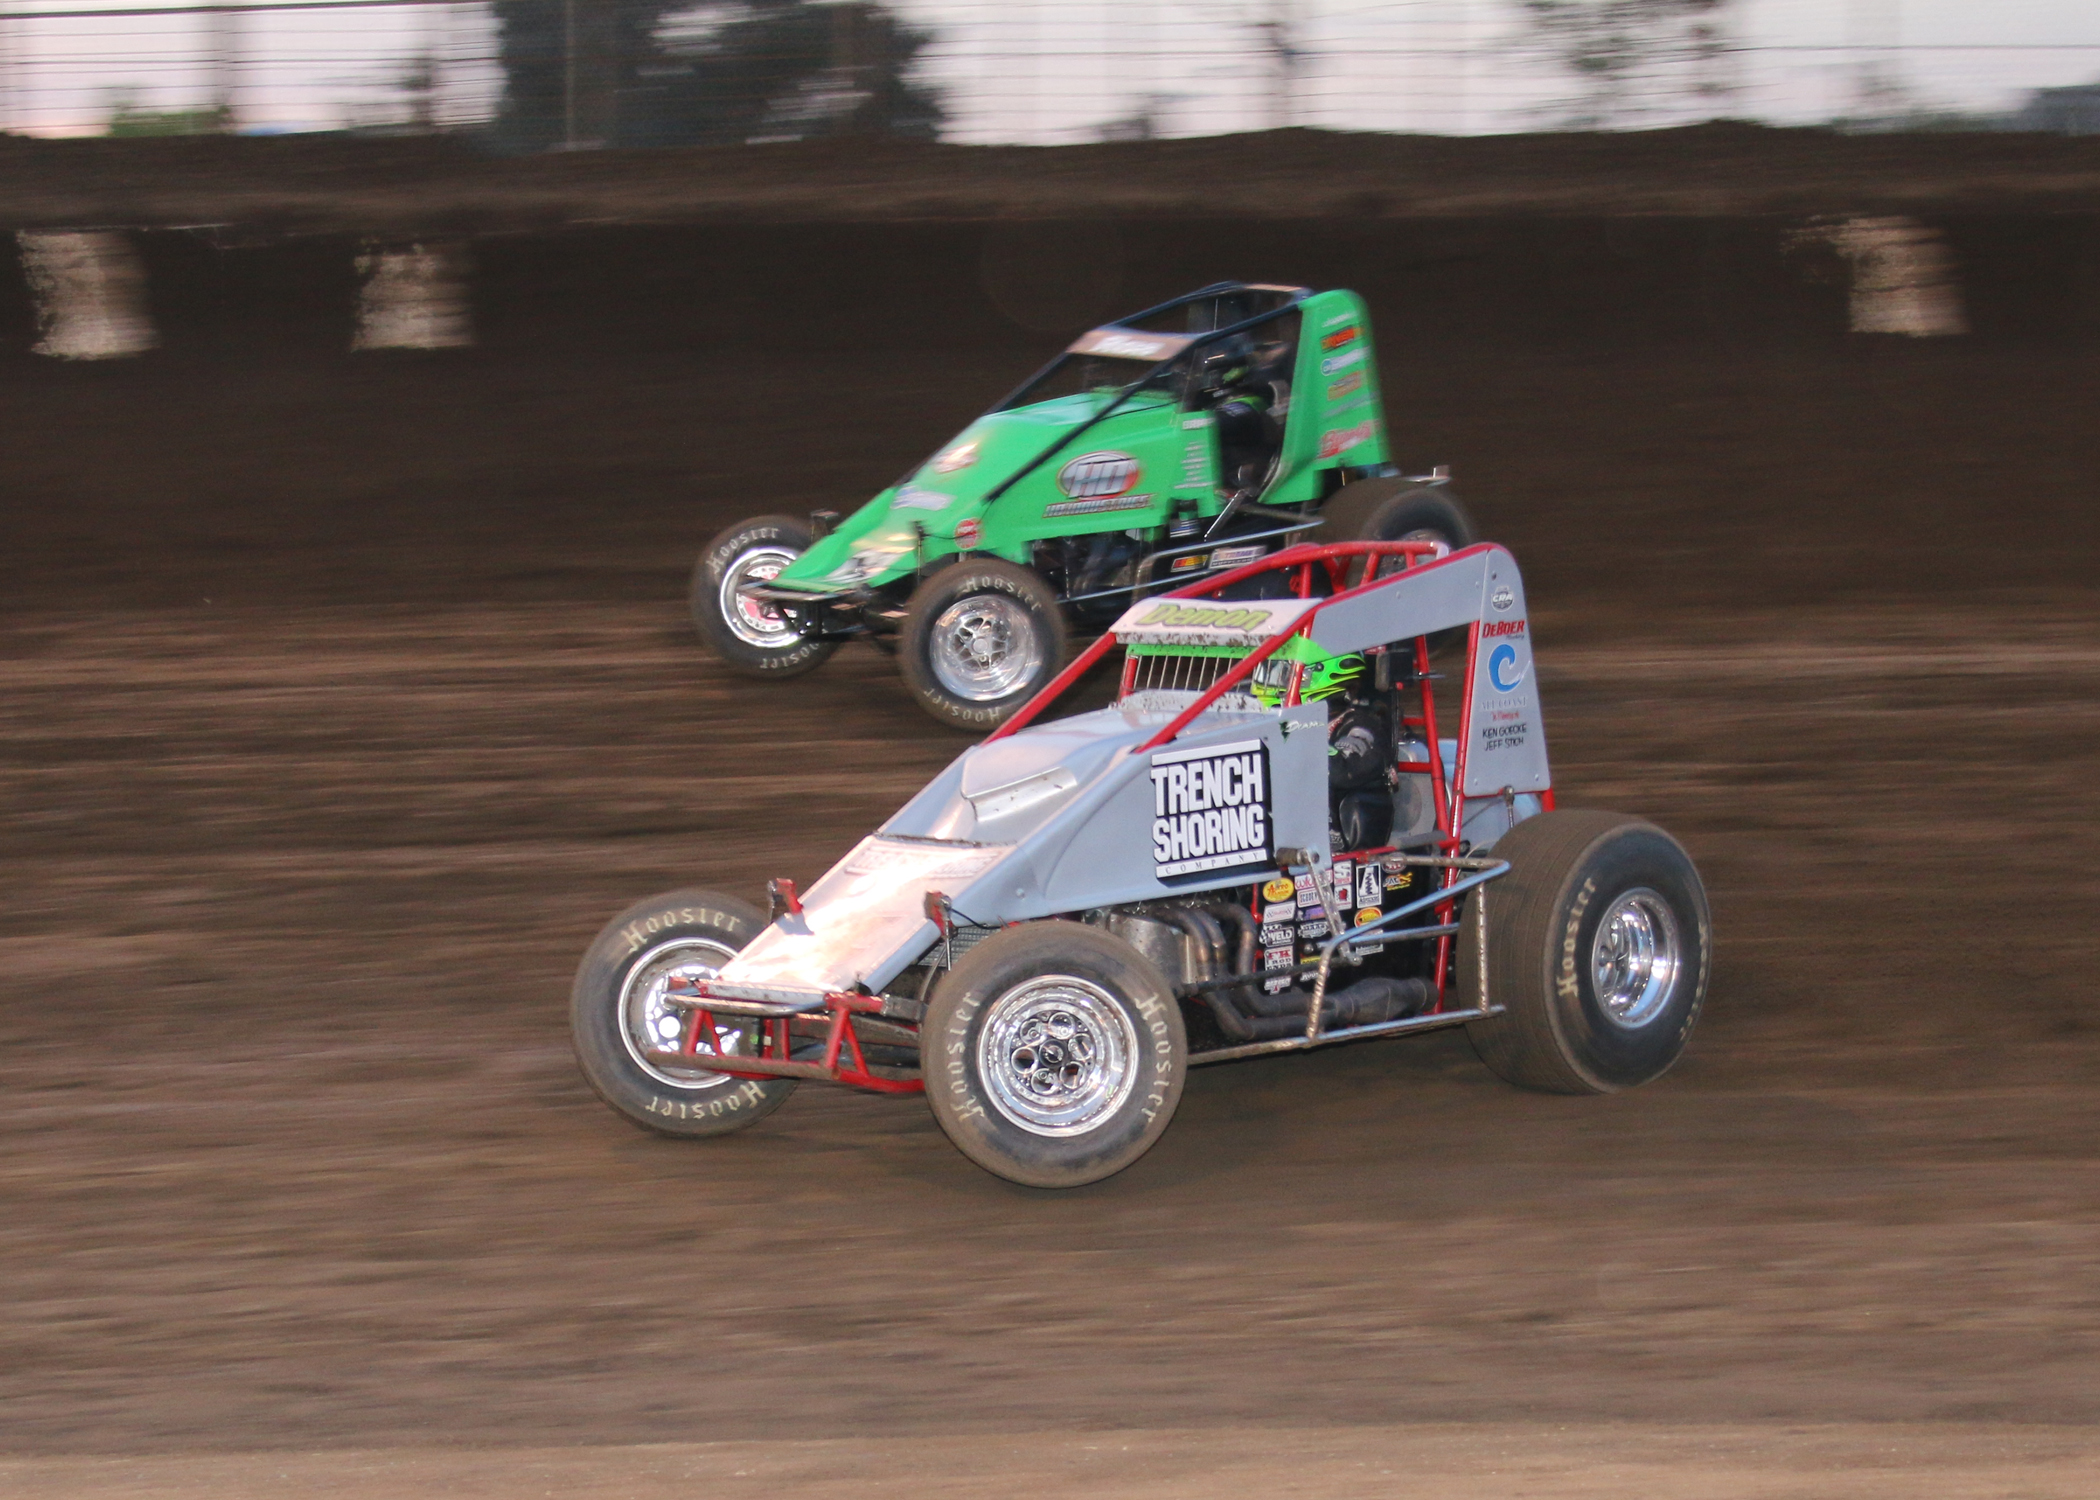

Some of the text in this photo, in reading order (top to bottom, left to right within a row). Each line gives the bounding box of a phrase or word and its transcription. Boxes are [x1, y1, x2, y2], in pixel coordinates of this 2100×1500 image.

[1482, 727, 1498, 739] KEN
[1484, 739, 1503, 752] JEFF
[1151, 753, 1263, 817] TRENCH
[1152, 804, 1265, 863] SHORING
[1165, 852, 1259, 875] COMPANY
[620, 908, 741, 953] Hoosier
[1266, 930, 1293, 941] WELD
[1556, 877, 1596, 998] Hoosier
[947, 991, 986, 1122] Hoosier
[1134, 991, 1173, 1123] Hoosier
[645, 1081, 767, 1119] Hoosier
